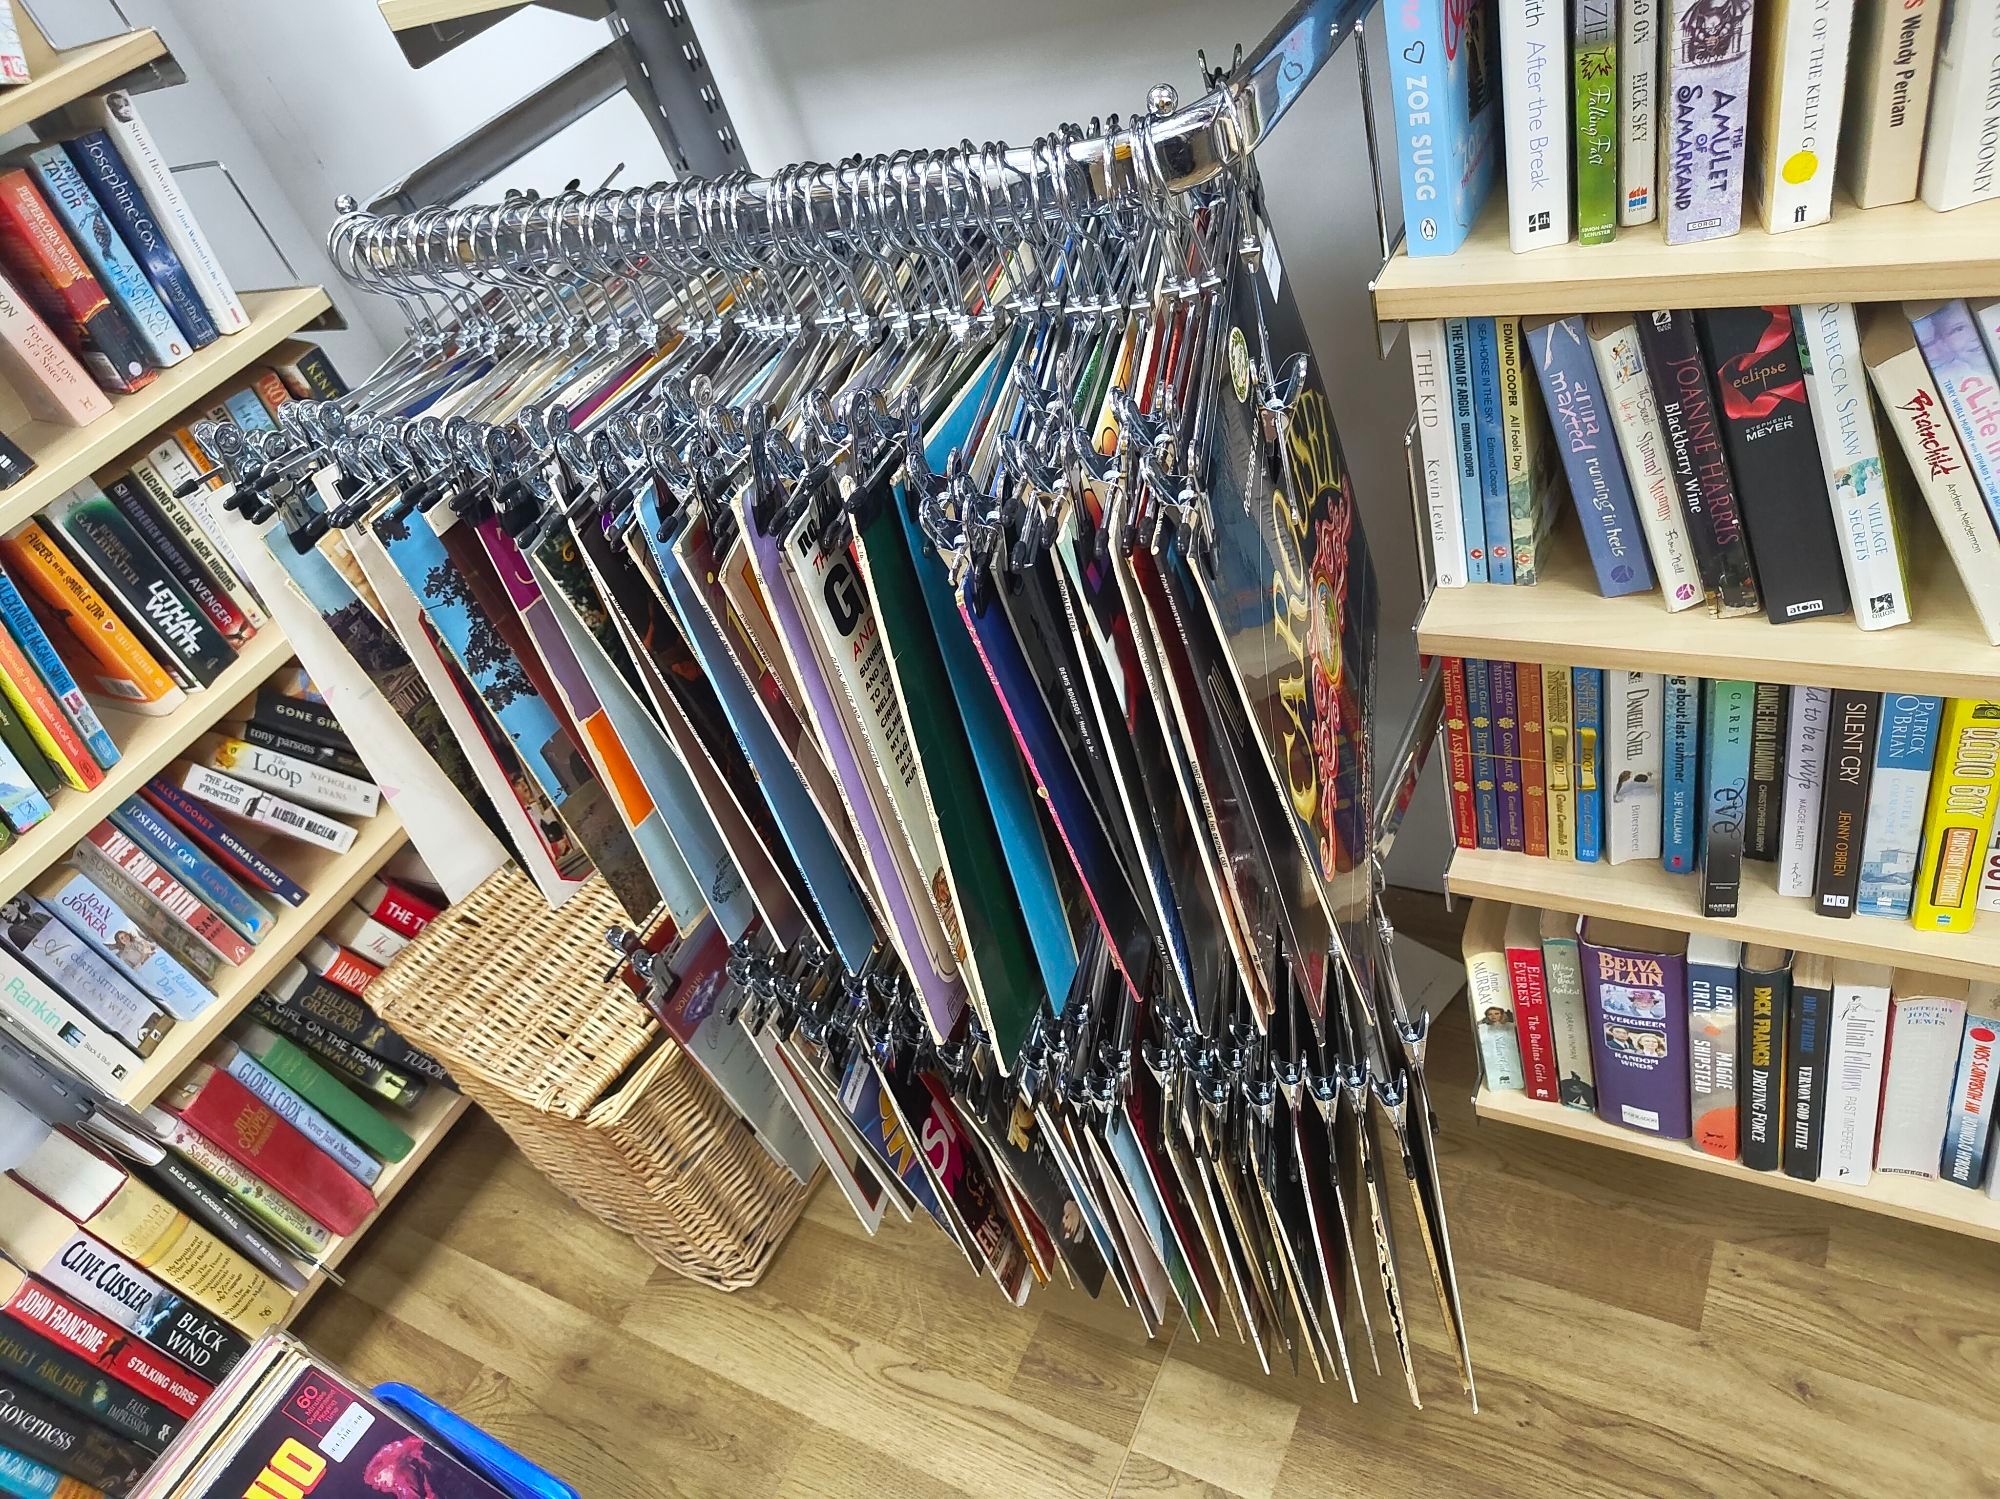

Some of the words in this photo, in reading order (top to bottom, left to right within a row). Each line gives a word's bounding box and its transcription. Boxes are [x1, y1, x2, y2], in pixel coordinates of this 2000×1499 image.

[1892, 14, 1922, 65] Wendy
[1526, 41, 1546, 94] After
[1809, 44, 1824, 80] THE
[1406, 75, 1431, 127] ZOE
[1633, 71, 1648, 109] RICK
[1803, 83, 1821, 131] KELLY
[1890, 69, 1915, 128] Perriam
[1528, 96, 1549, 132] the
[1632, 111, 1647, 143] SKY
[1675, 85, 1703, 211] SAMARKAND
[1695, 133, 1708, 153] OF
[1708, 89, 1737, 193] AMULET
[1732, 126, 1744, 149] THE
[1972, 117, 2000, 193] MOONEY
[57, 159, 91, 203] ANDREW
[1411, 134, 1437, 201] SUGG
[1529, 135, 1549, 192] Break
[42, 159, 83, 210] TAYLOR
[85, 140, 140, 221] Josephine
[135, 216, 159, 253] Cox
[16, 186, 60, 247] PEPPERCORN
[56, 243, 84, 281] WOMAN
[1583, 229, 1611, 238] SCHUSTER
[1451, 325, 1463, 342] THE
[1503, 324, 1514, 366] EDMUND
[306, 360, 326, 390] KEN
[1416, 349, 1435, 387] THE
[1453, 343, 1466, 375] VENOM
[1733, 361, 1787, 390] eclipse
[1456, 377, 1467, 387] OF
[1506, 368, 1517, 406] COOPER
[1818, 301, 1850, 397] REBECCA
[1835, 398, 1862, 457] SHAW
[1421, 394, 1438, 428] KID
[1457, 388, 1470, 417] ARGUS
[1510, 415, 1520, 428] All
[1551, 372, 1594, 453] maxted
[1573, 380, 1600, 437] anna
[1461, 423, 1472, 451] EDMUND
[1667, 355, 1718, 456] JOANNE
[1700, 455, 1739, 545] HARRIS
[1746, 419, 1794, 443] MEYER
[1895, 388, 1962, 484] Brainchild
[1464, 452, 1474, 478] COOPER
[1512, 455, 1521, 471] Day
[1664, 401, 1693, 476] Blackberry
[1684, 475, 1701, 514] Wine
[1427, 459, 1442, 498] Kevin
[1432, 505, 1446, 541] Lewis
[1585, 456, 1614, 511] running
[1603, 528, 1624, 558] heels
[139, 467, 175, 512] LUCIANO'S
[172, 511, 194, 536] LUCK
[191, 537, 213, 561] JACK
[206, 556, 237, 592] HIGGINS
[1848, 508, 1870, 562] SECRETS
[1866, 501, 1888, 557] VILLAGE
[75, 512, 140, 586] GALBRAITH
[148, 580, 203, 638] LETHAL
[189, 577, 232, 626] AVENGER
[1058, 579, 1071, 611] DONALD
[1788, 602, 1821, 615] atom
[145, 596, 201, 655] WHITE
[853, 616, 876, 662] AND
[1058, 666, 1071, 687] DEMIS
[1067, 687, 1081, 716] ROUSSOS
[1676, 689, 1692, 716] about
[275, 704, 313, 723] GONE
[1675, 715, 1691, 740] last
[1728, 692, 1742, 745] CAREY
[1843, 702, 1867, 753] SILENT
[1889, 695, 1920, 759] O'BRIAN
[1909, 701, 1935, 756] PATRICK
[250, 727, 275, 745] tony
[275, 736, 316, 756] parsons
[1452, 733, 1466, 783] ASSASSIN
[1476, 732, 1488, 777] BETRAYAL
[1753, 739, 1776, 782] DIAMOND
[1953, 727, 2000, 780] RADIO
[203, 773, 222, 788] THE
[252, 752, 302, 789] Loop
[310, 771, 358, 792] NICHOLAS
[1674, 741, 1685, 783] summer
[1788, 758, 1819, 790] Wife
[1839, 755, 1862, 786] CRY
[1674, 791, 1684, 806] SUE
[1712, 777, 1746, 840] eve
[1946, 784, 1992, 821] BOY
[128, 804, 179, 850] JOSEPHINE
[177, 846, 199, 869] COX
[178, 799, 215, 831] ROONEY
[220, 833, 253, 863] NORMAL
[252, 859, 284, 887] PEOPLE
[270, 806, 305, 829] ALISTAIR
[304, 820, 339, 842] MACLEAN
[1674, 806, 1684, 845] WALLMAN
[1835, 810, 1852, 843] JENNY
[101, 830, 134, 863] THE
[128, 853, 159, 883] END
[159, 881, 201, 920] FAITH
[62, 896, 108, 939] JONKER
[78, 886, 114, 922] JOAN
[387, 901, 415, 925] THE
[1597, 951, 1663, 974] BELVA
[1600, 968, 1664, 988] PLAIN
[4, 975, 61, 1030] Rankin
[1513, 961, 1530, 1008] EVEREST
[1527, 965, 1542, 1006] ELAINE
[1692, 980, 1711, 1018] CIRCLE
[1754, 986, 1772, 1017] DICK
[275, 1002, 302, 1026] GIRL
[306, 1020, 325, 1037] ON
[327, 1030, 350, 1051] THE
[350, 1043, 385, 1072] TRAIN
[1527, 1015, 1537, 1031] The
[1602, 1013, 1666, 1029] EVERGREEN
[252, 1005, 299, 1037] PAULA
[304, 1034, 367, 1077] HAWKINS
[1614, 1052, 1659, 1065] RANDOM
[1974, 1044, 1992, 1062] SON
[238, 1062, 274, 1102] GLORIA
[403, 1050, 447, 1080] TUDOR
[1621, 1060, 1654, 1071] WINDS
[1694, 1039, 1711, 1095] SHIPSTEAD
[1715, 1051, 1733, 1091] MAGGIE
[1967, 1062, 1988, 1102] HUSBAND'S
[1752, 1069, 1769, 1112] DRIVING
[1751, 1107, 1768, 1144] FORCE
[1797, 1103, 1810, 1120] GOD
[1795, 1120, 1809, 1151] LITTLE
[216, 1167, 239, 1188] Club
[1952, 1152, 1972, 1181] DEBORAH
[169, 1166, 187, 1183] SAGA
[200, 1194, 222, 1215] GOOSE
[221, 1211, 239, 1230] TRAIL
[60, 1240, 102, 1281] CLIVE
[96, 1261, 153, 1315] CUSSLER
[15, 1289, 54, 1318] JOHN
[48, 1298, 108, 1354] FRANCOME
[176, 1311, 229, 1353] BLACK
[166, 1329, 211, 1368] WIND
[127, 1356, 170, 1390] STALKING
[169, 1382, 199, 1406] HORSE
[297, 1386, 317, 1408] 60
[107, 1405, 153, 1436] IMPRESSION
[125, 1398, 151, 1416] FALSE
